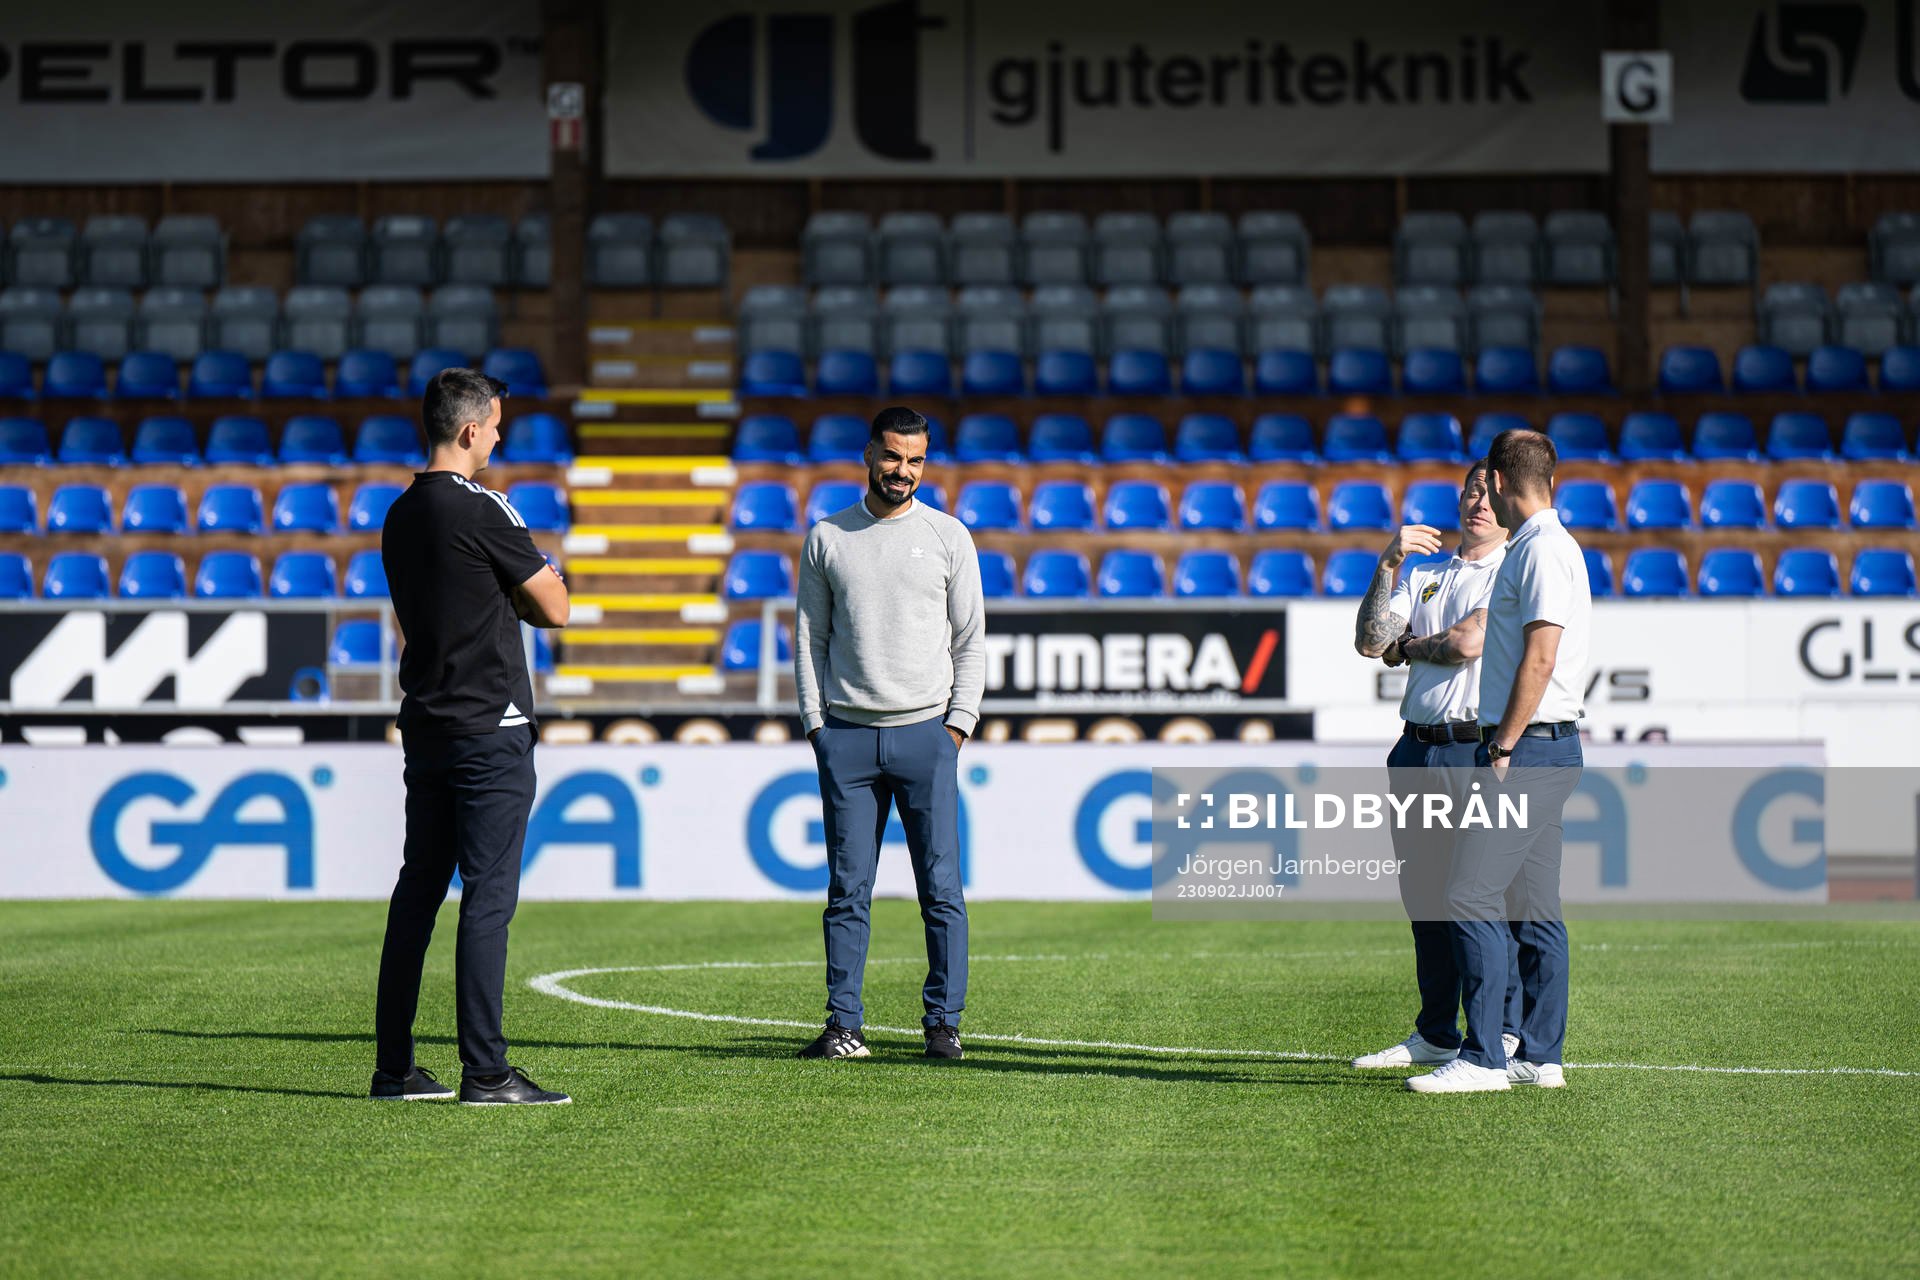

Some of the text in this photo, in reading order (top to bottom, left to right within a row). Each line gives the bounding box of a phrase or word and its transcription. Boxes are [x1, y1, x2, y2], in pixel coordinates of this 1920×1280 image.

[988, 36, 1533, 153] gjuteriteknik
[1615, 60, 1659, 114] G
[88, 770, 316, 894] GA
